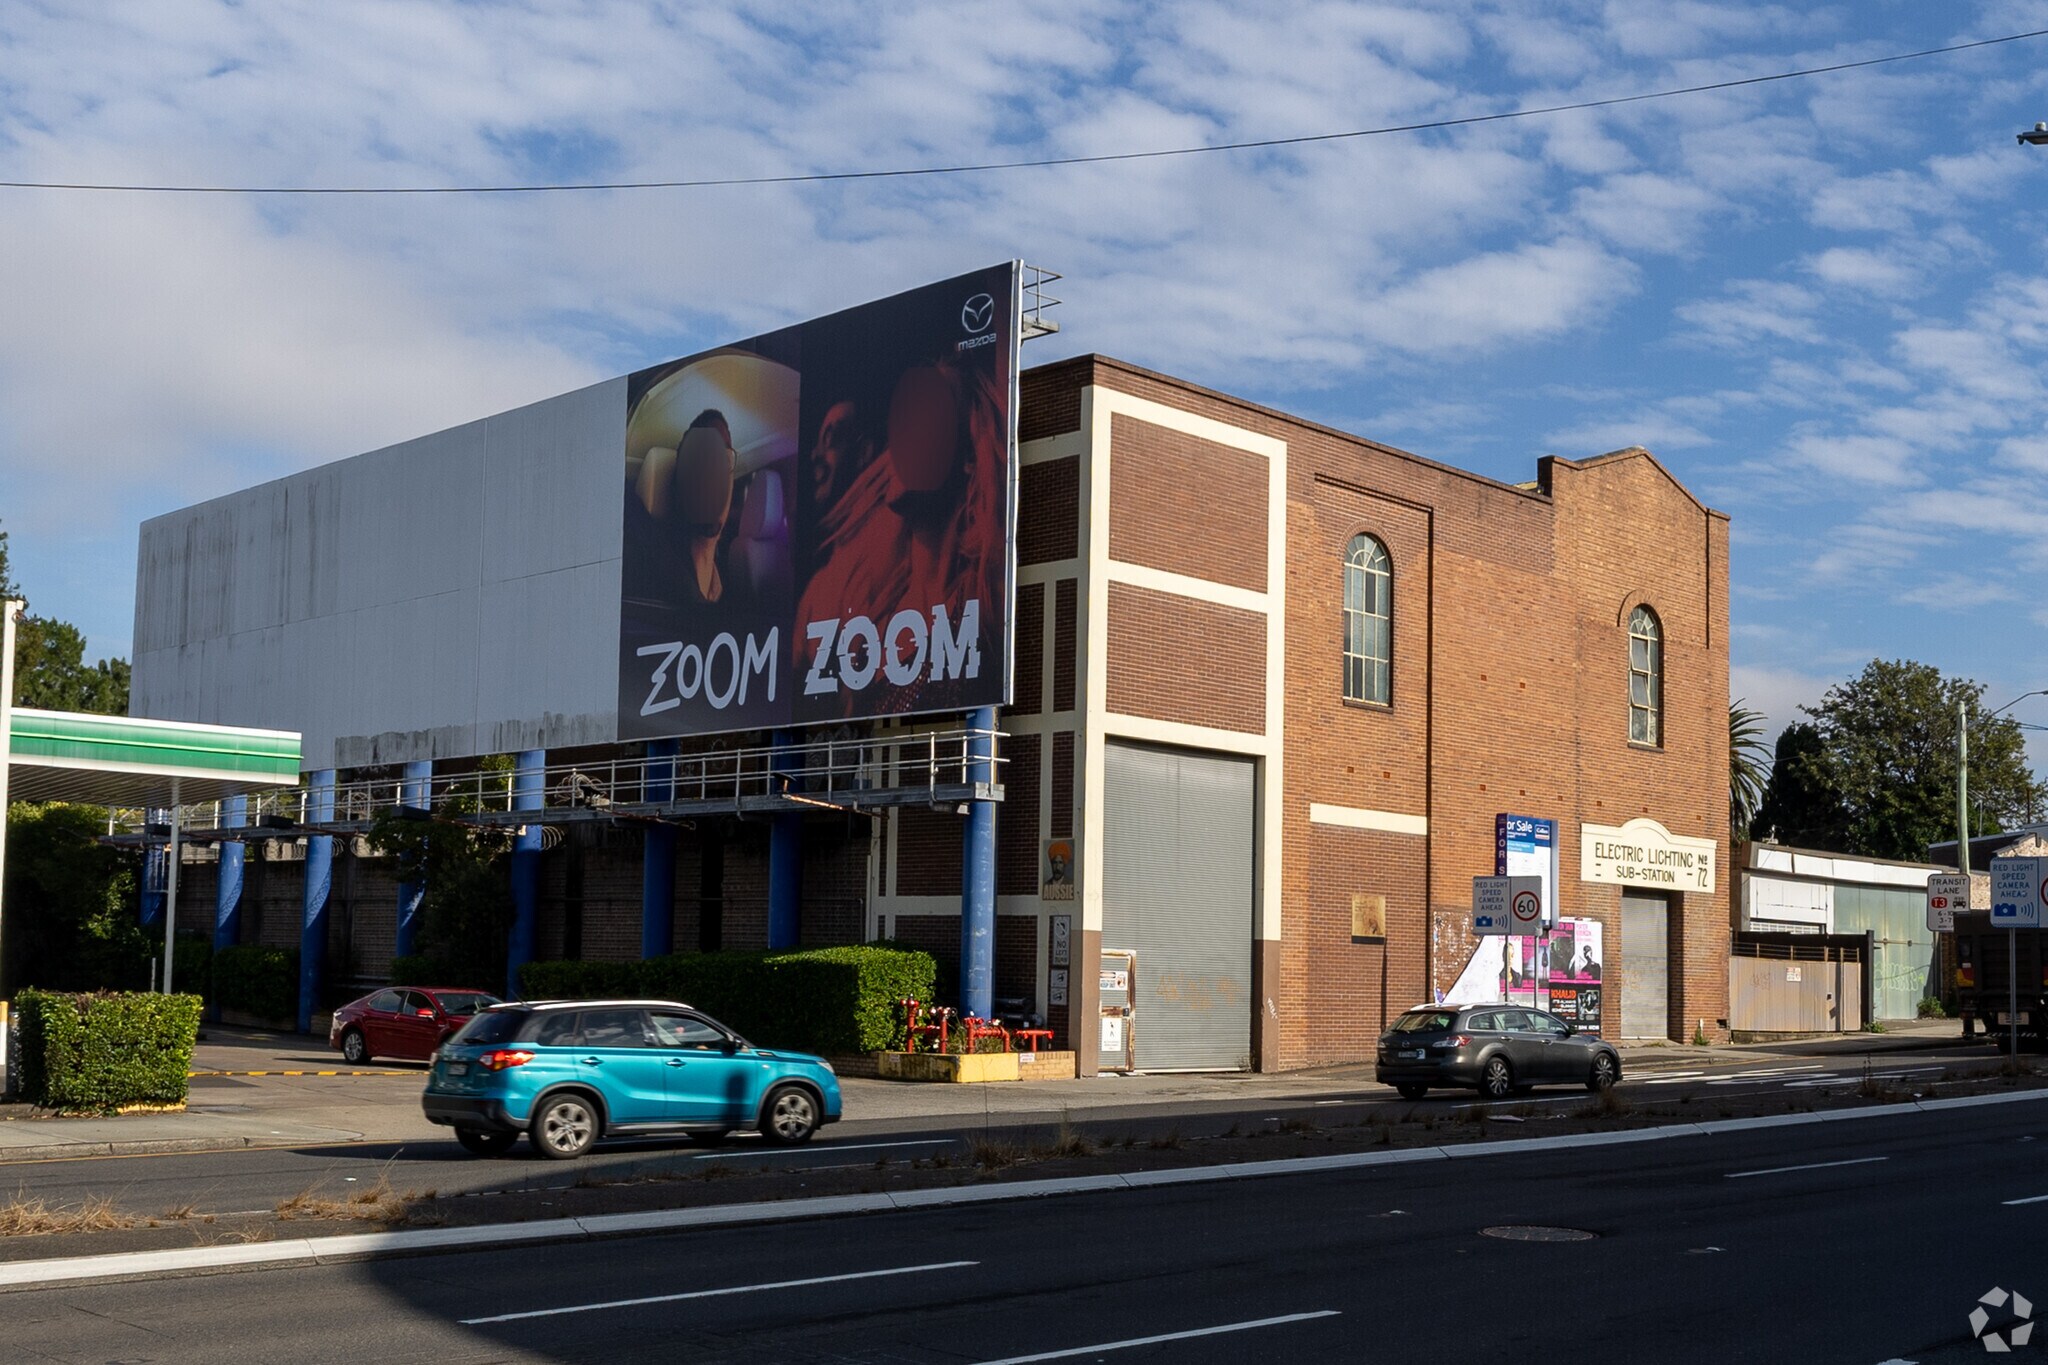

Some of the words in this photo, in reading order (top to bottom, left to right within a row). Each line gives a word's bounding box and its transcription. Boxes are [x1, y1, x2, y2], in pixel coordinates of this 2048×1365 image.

[958, 333, 997, 351] mazda
[804, 599, 981, 695] ZOOM
[637, 626, 779, 717] ZOOM
[1507, 821, 1515, 830] or
[1516, 820, 1533, 833] Sale
[1595, 842, 1643, 863] ELECTRIC
[1993, 864, 2008, 872] RED
[2012, 863, 2034, 871] LIGHT
[1616, 865, 1675, 883] SUB-STATION
[1697, 867, 1708, 887] 72
[1931, 878, 1966, 886] TRANSIT
[1043, 884, 1074, 900] AUSSIE
[1517, 899, 1535, 913] 60
[1933, 898, 1946, 907] T3
[1056, 940, 1066, 948] NO
[1551, 989, 1576, 999] KHALID
